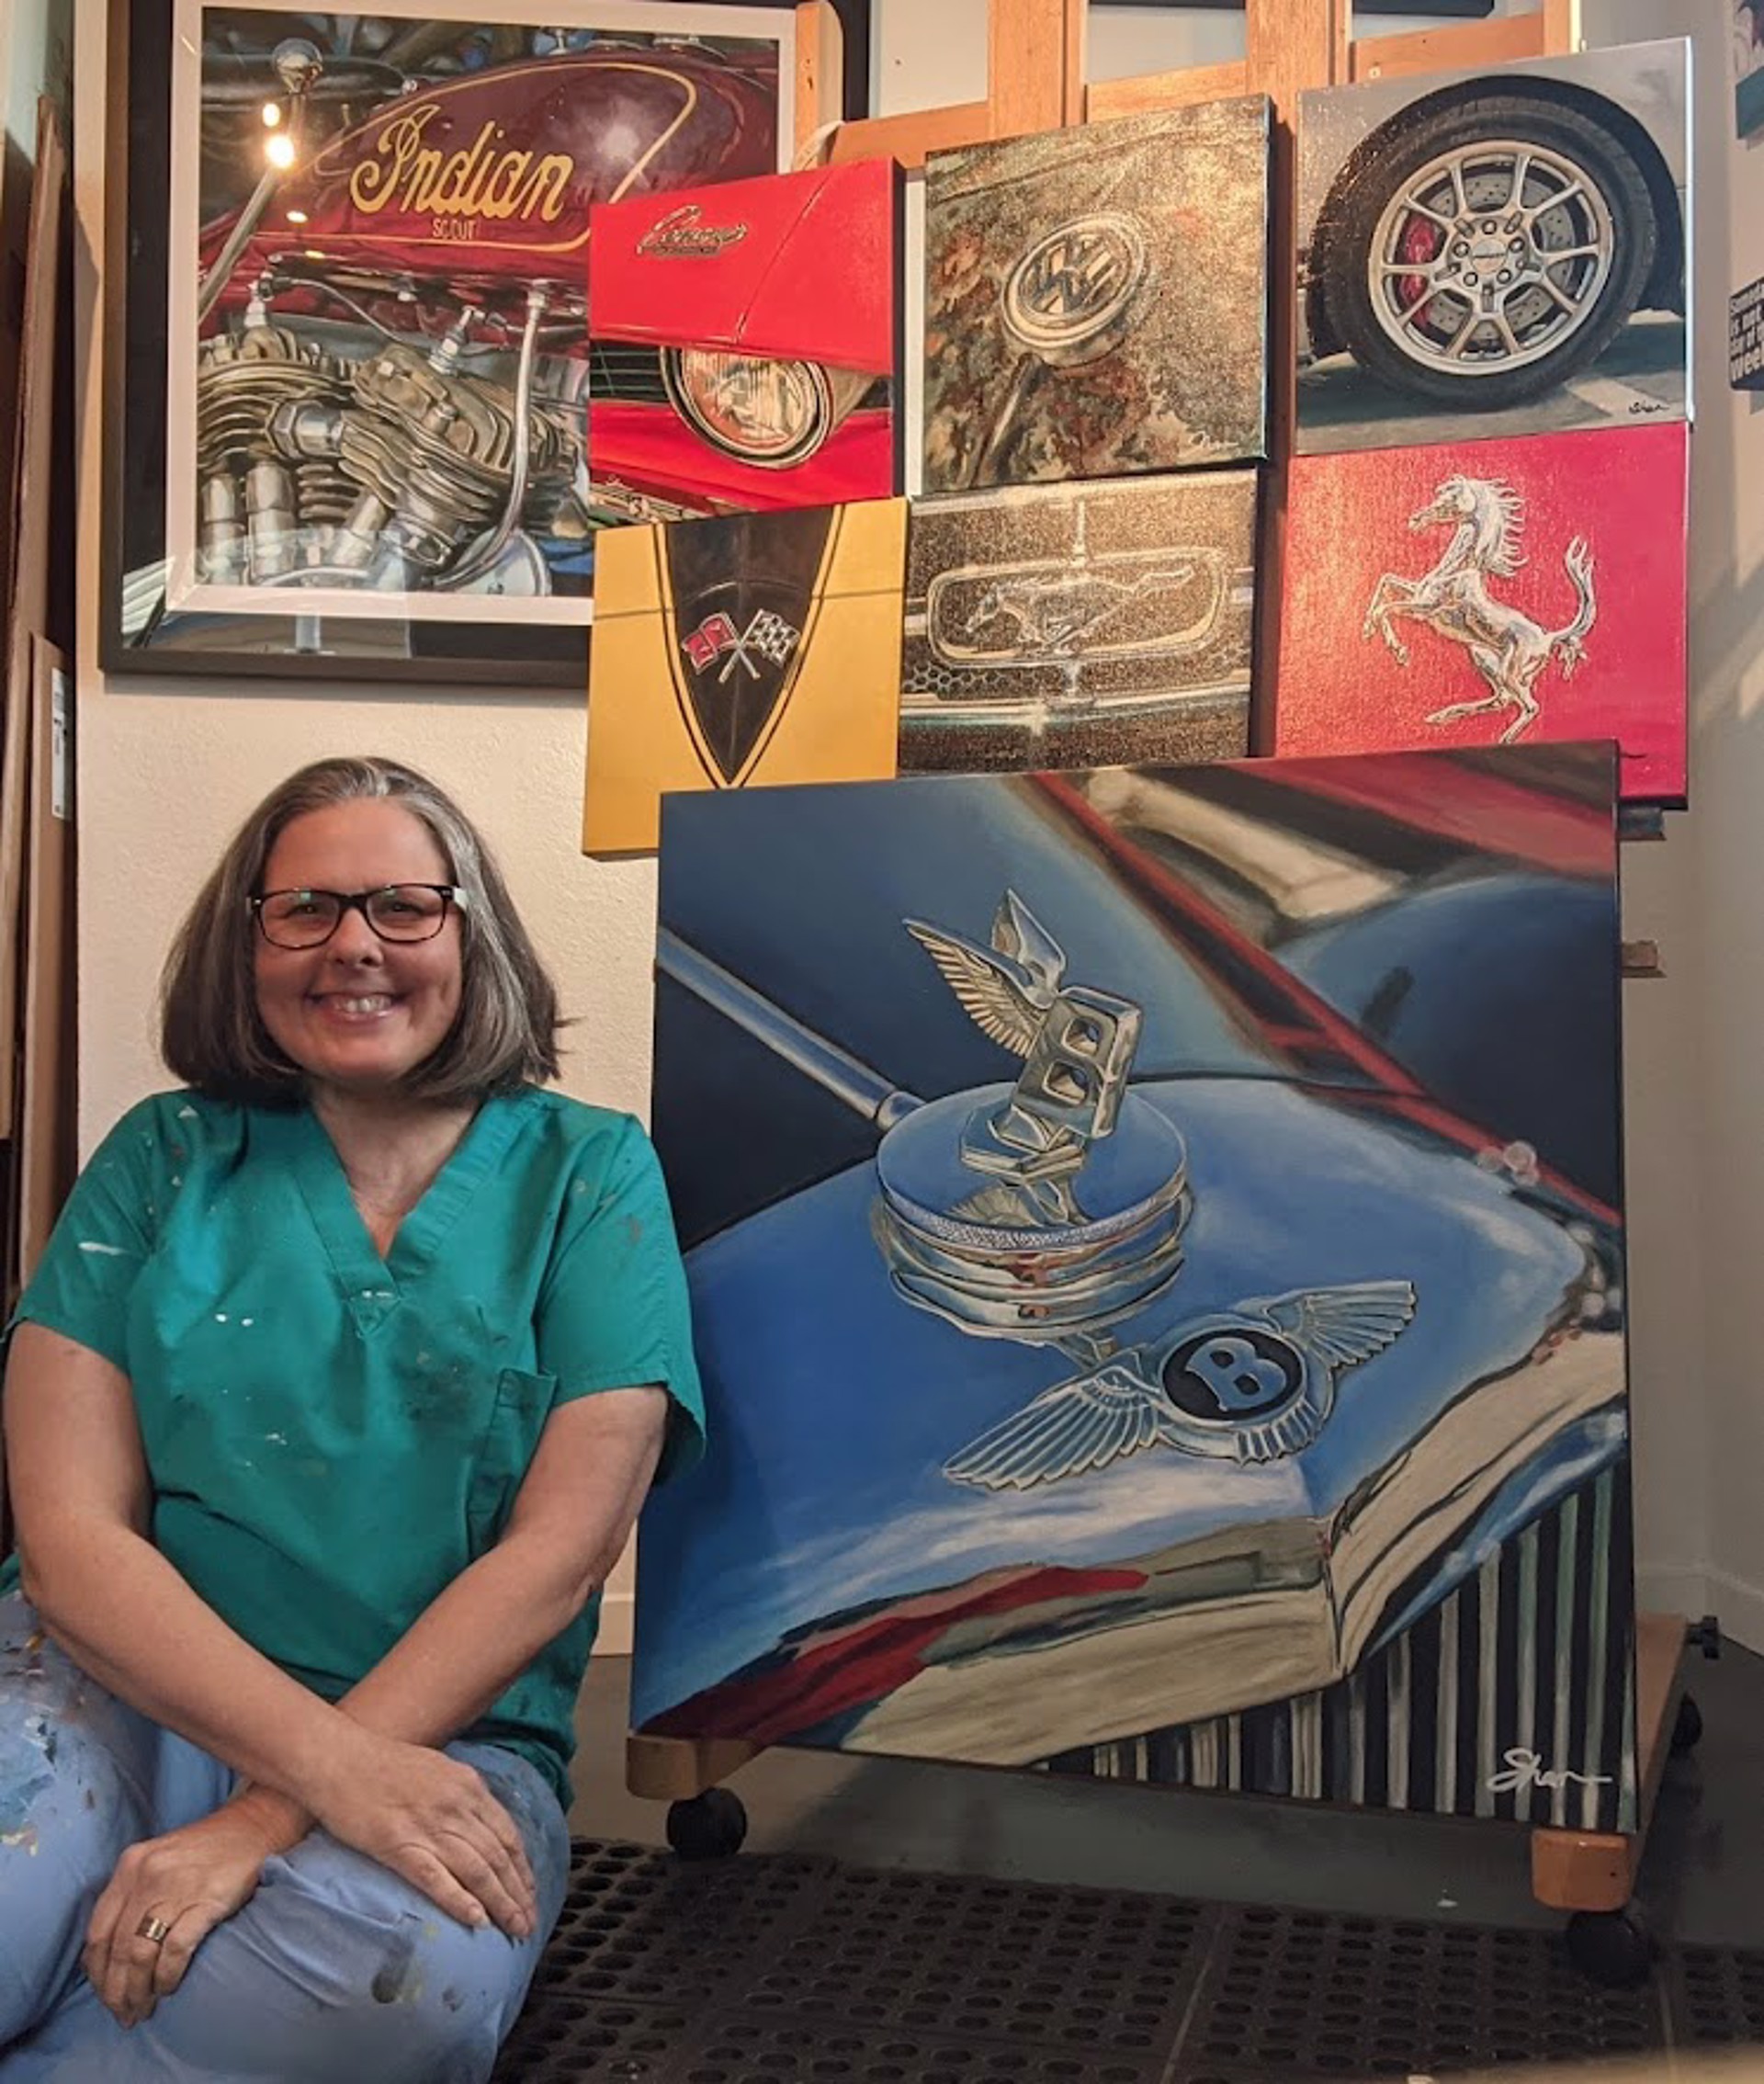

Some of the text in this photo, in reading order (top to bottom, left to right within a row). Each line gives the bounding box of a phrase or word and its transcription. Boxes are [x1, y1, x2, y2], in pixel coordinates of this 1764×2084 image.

[350, 103, 574, 222] Indian
[432, 218, 477, 240] SCOUT
[1184, 1337, 1286, 1411] B
